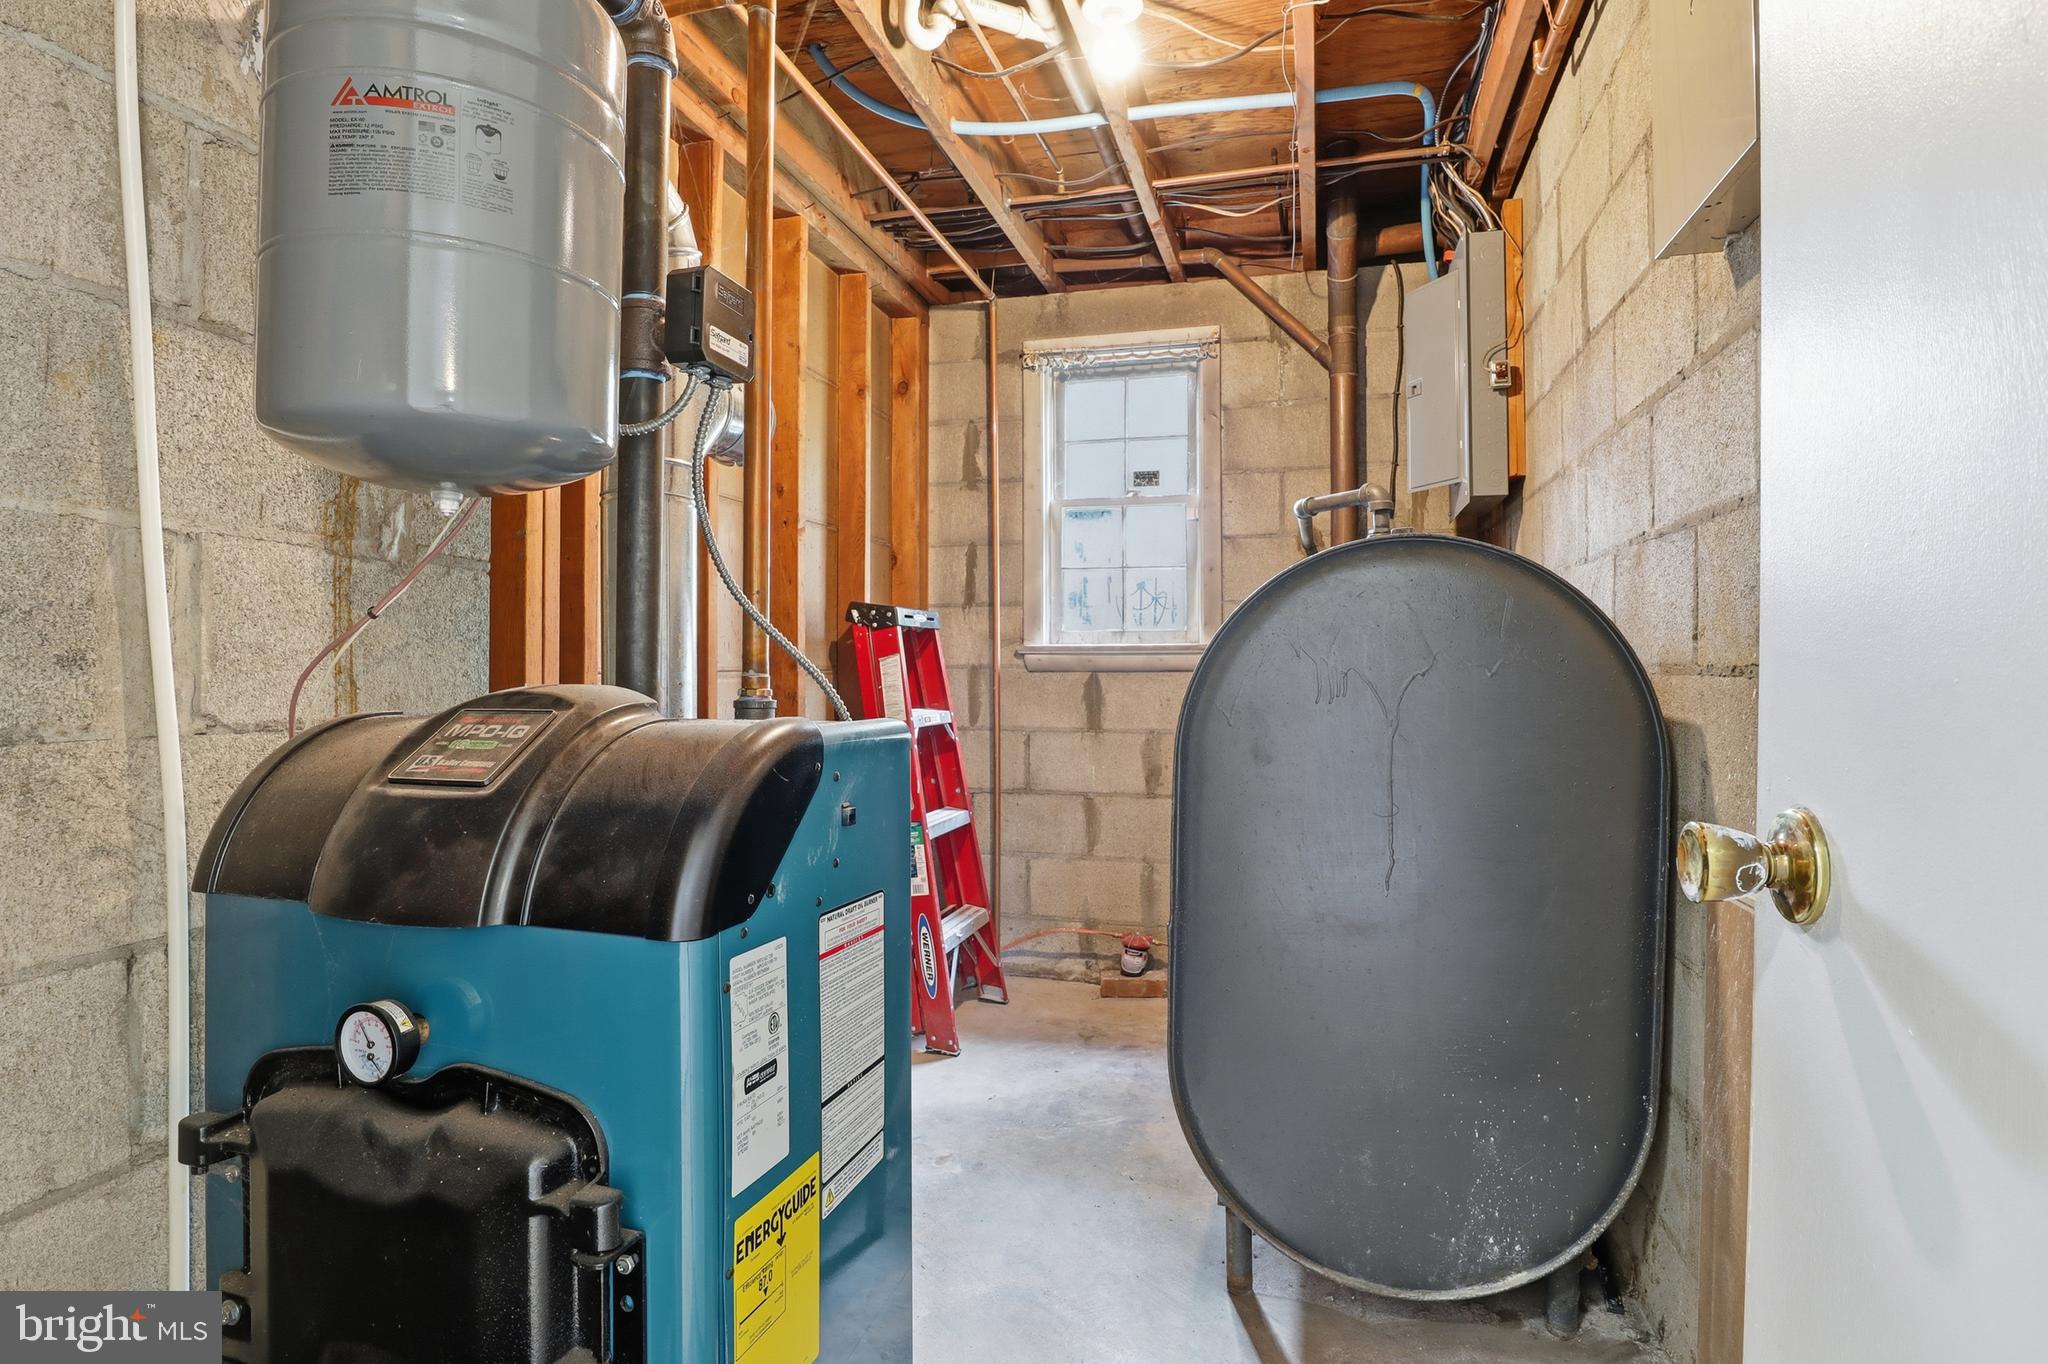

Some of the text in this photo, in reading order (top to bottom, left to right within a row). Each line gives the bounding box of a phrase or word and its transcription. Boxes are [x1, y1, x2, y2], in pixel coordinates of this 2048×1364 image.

[364, 83, 453, 107] AMTROL
[413, 102, 455, 116] EXTROL
[444, 724, 531, 739] MPO-IQ
[922, 932, 934, 981] WERNER
[736, 1175, 817, 1265] ENERGYGUIDE
[758, 1271, 773, 1292] 87.0
